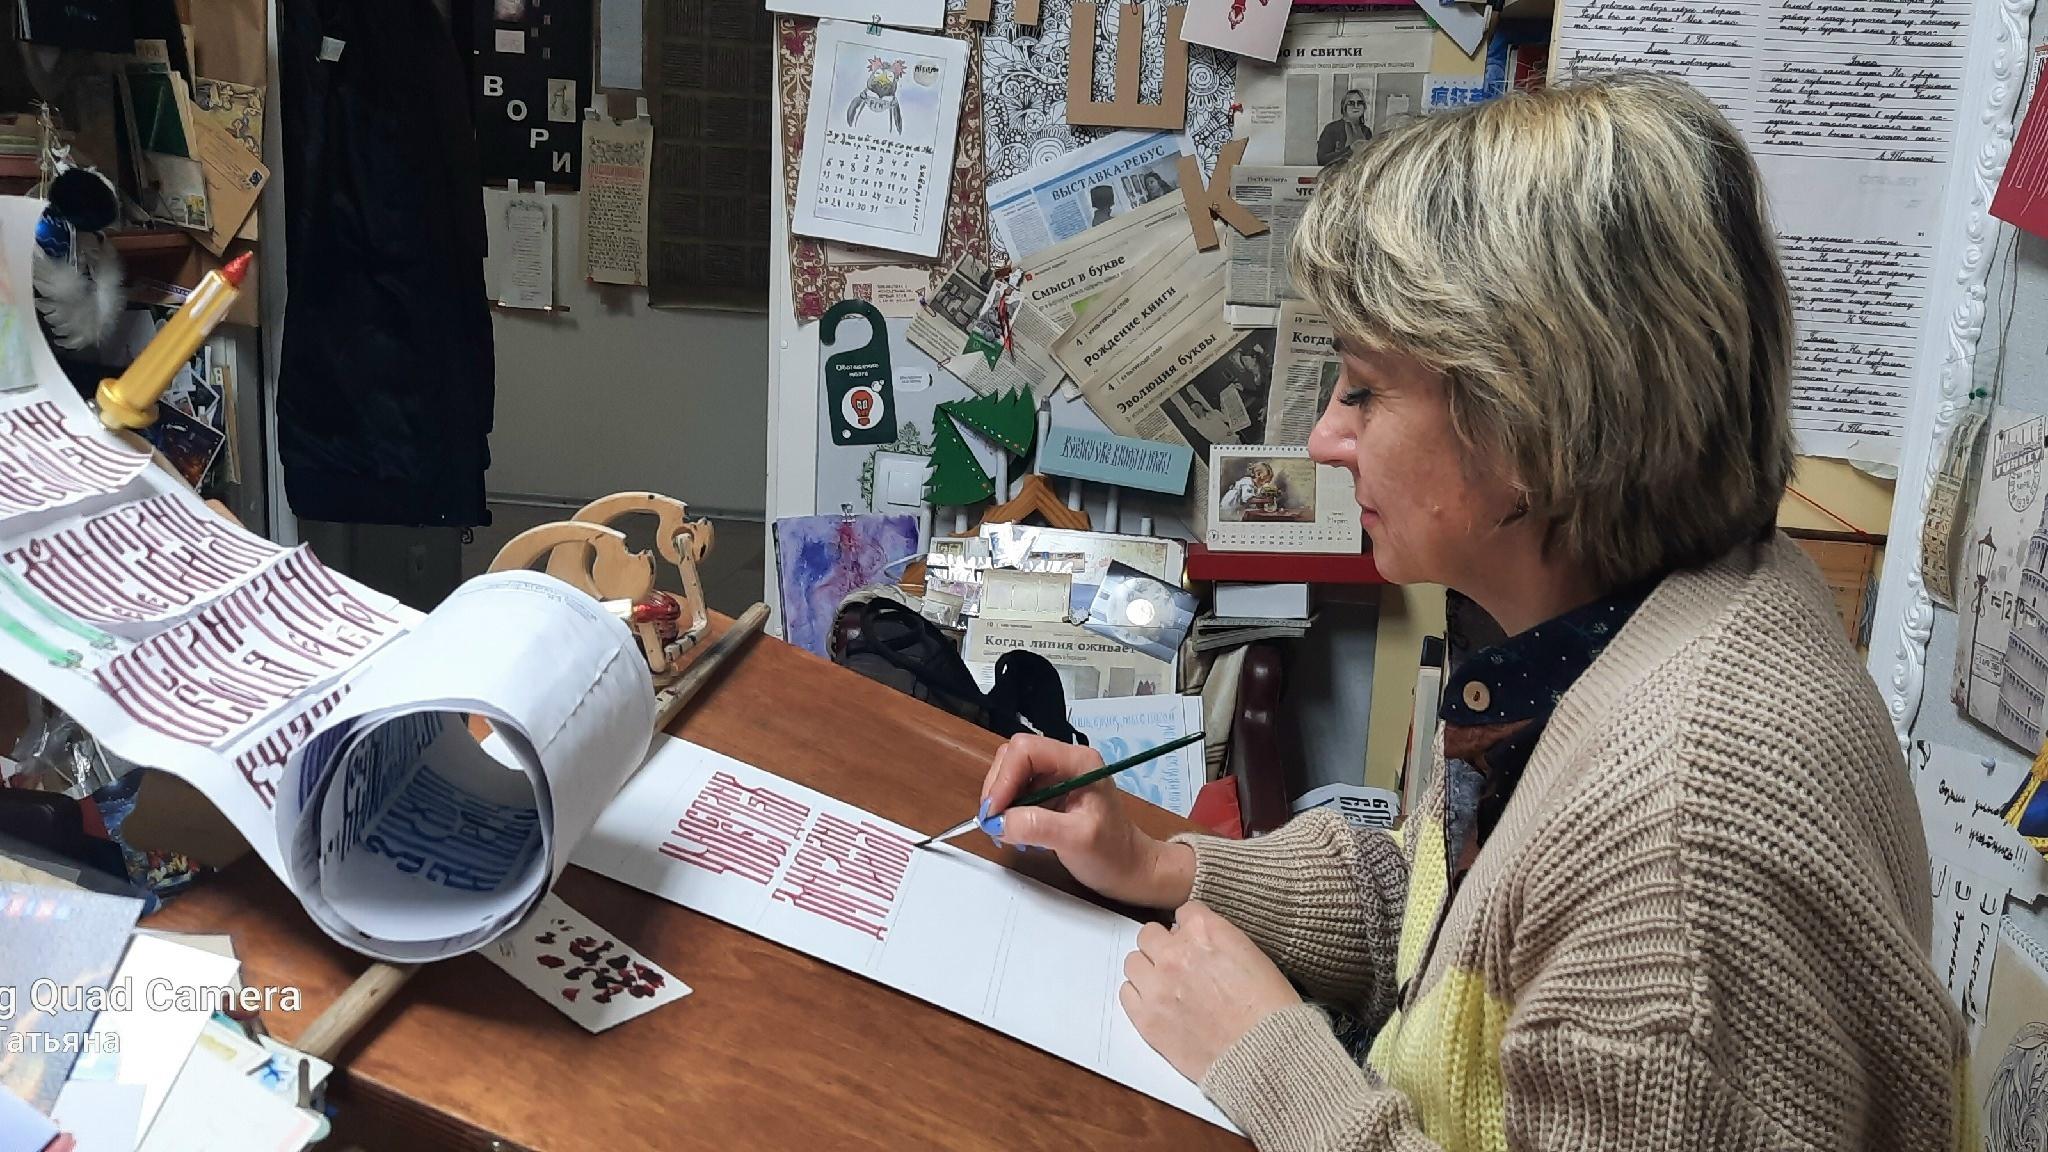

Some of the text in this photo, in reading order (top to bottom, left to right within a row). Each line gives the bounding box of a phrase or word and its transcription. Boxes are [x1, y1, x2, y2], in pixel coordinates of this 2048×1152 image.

[1296, 48, 1305, 57] и
[1310, 47, 1363, 57] свитки
[1052, 145, 1166, 201] ВЫСТАВКА-РЕБУС
[1031, 275, 1075, 302] Смысл
[1078, 272, 1086, 284] в
[1088, 254, 1127, 279] букве
[1084, 314, 1141, 367] Рождение
[1142, 285, 1178, 322] книги
[1291, 331, 1333, 346] Когда
[1116, 361, 1178, 415] Эволюция
[1178, 332, 1217, 367] буквы
[985, 635, 1136, 654] Когда линия оживает
